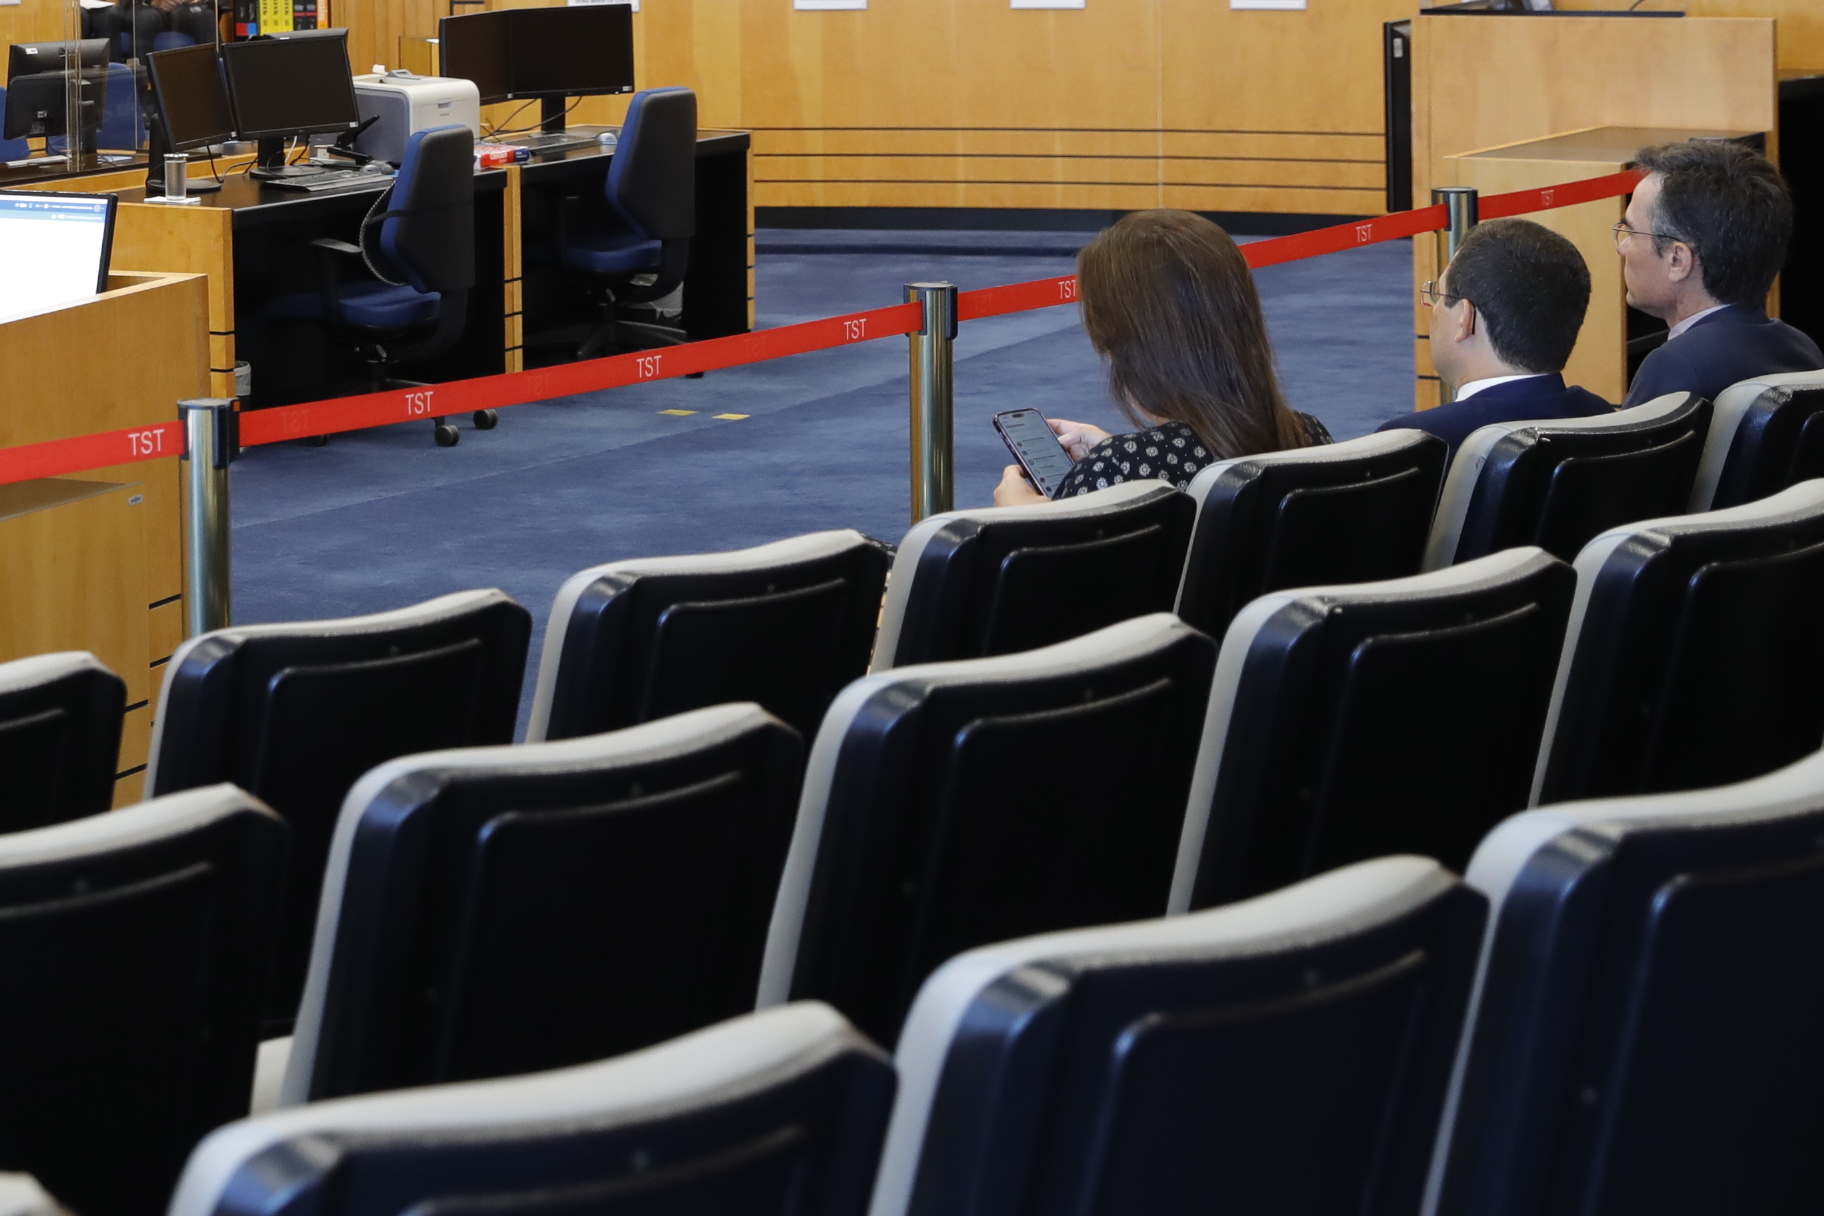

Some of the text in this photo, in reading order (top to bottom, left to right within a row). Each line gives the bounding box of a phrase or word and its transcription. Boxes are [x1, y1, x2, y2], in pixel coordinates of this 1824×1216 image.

[1356, 224, 1373, 243] TST
[1058, 279, 1077, 300] TST
[843, 318, 867, 340] TST
[636, 355, 662, 379] TST
[405, 391, 434, 416] TST
[128, 428, 165, 456] TST
